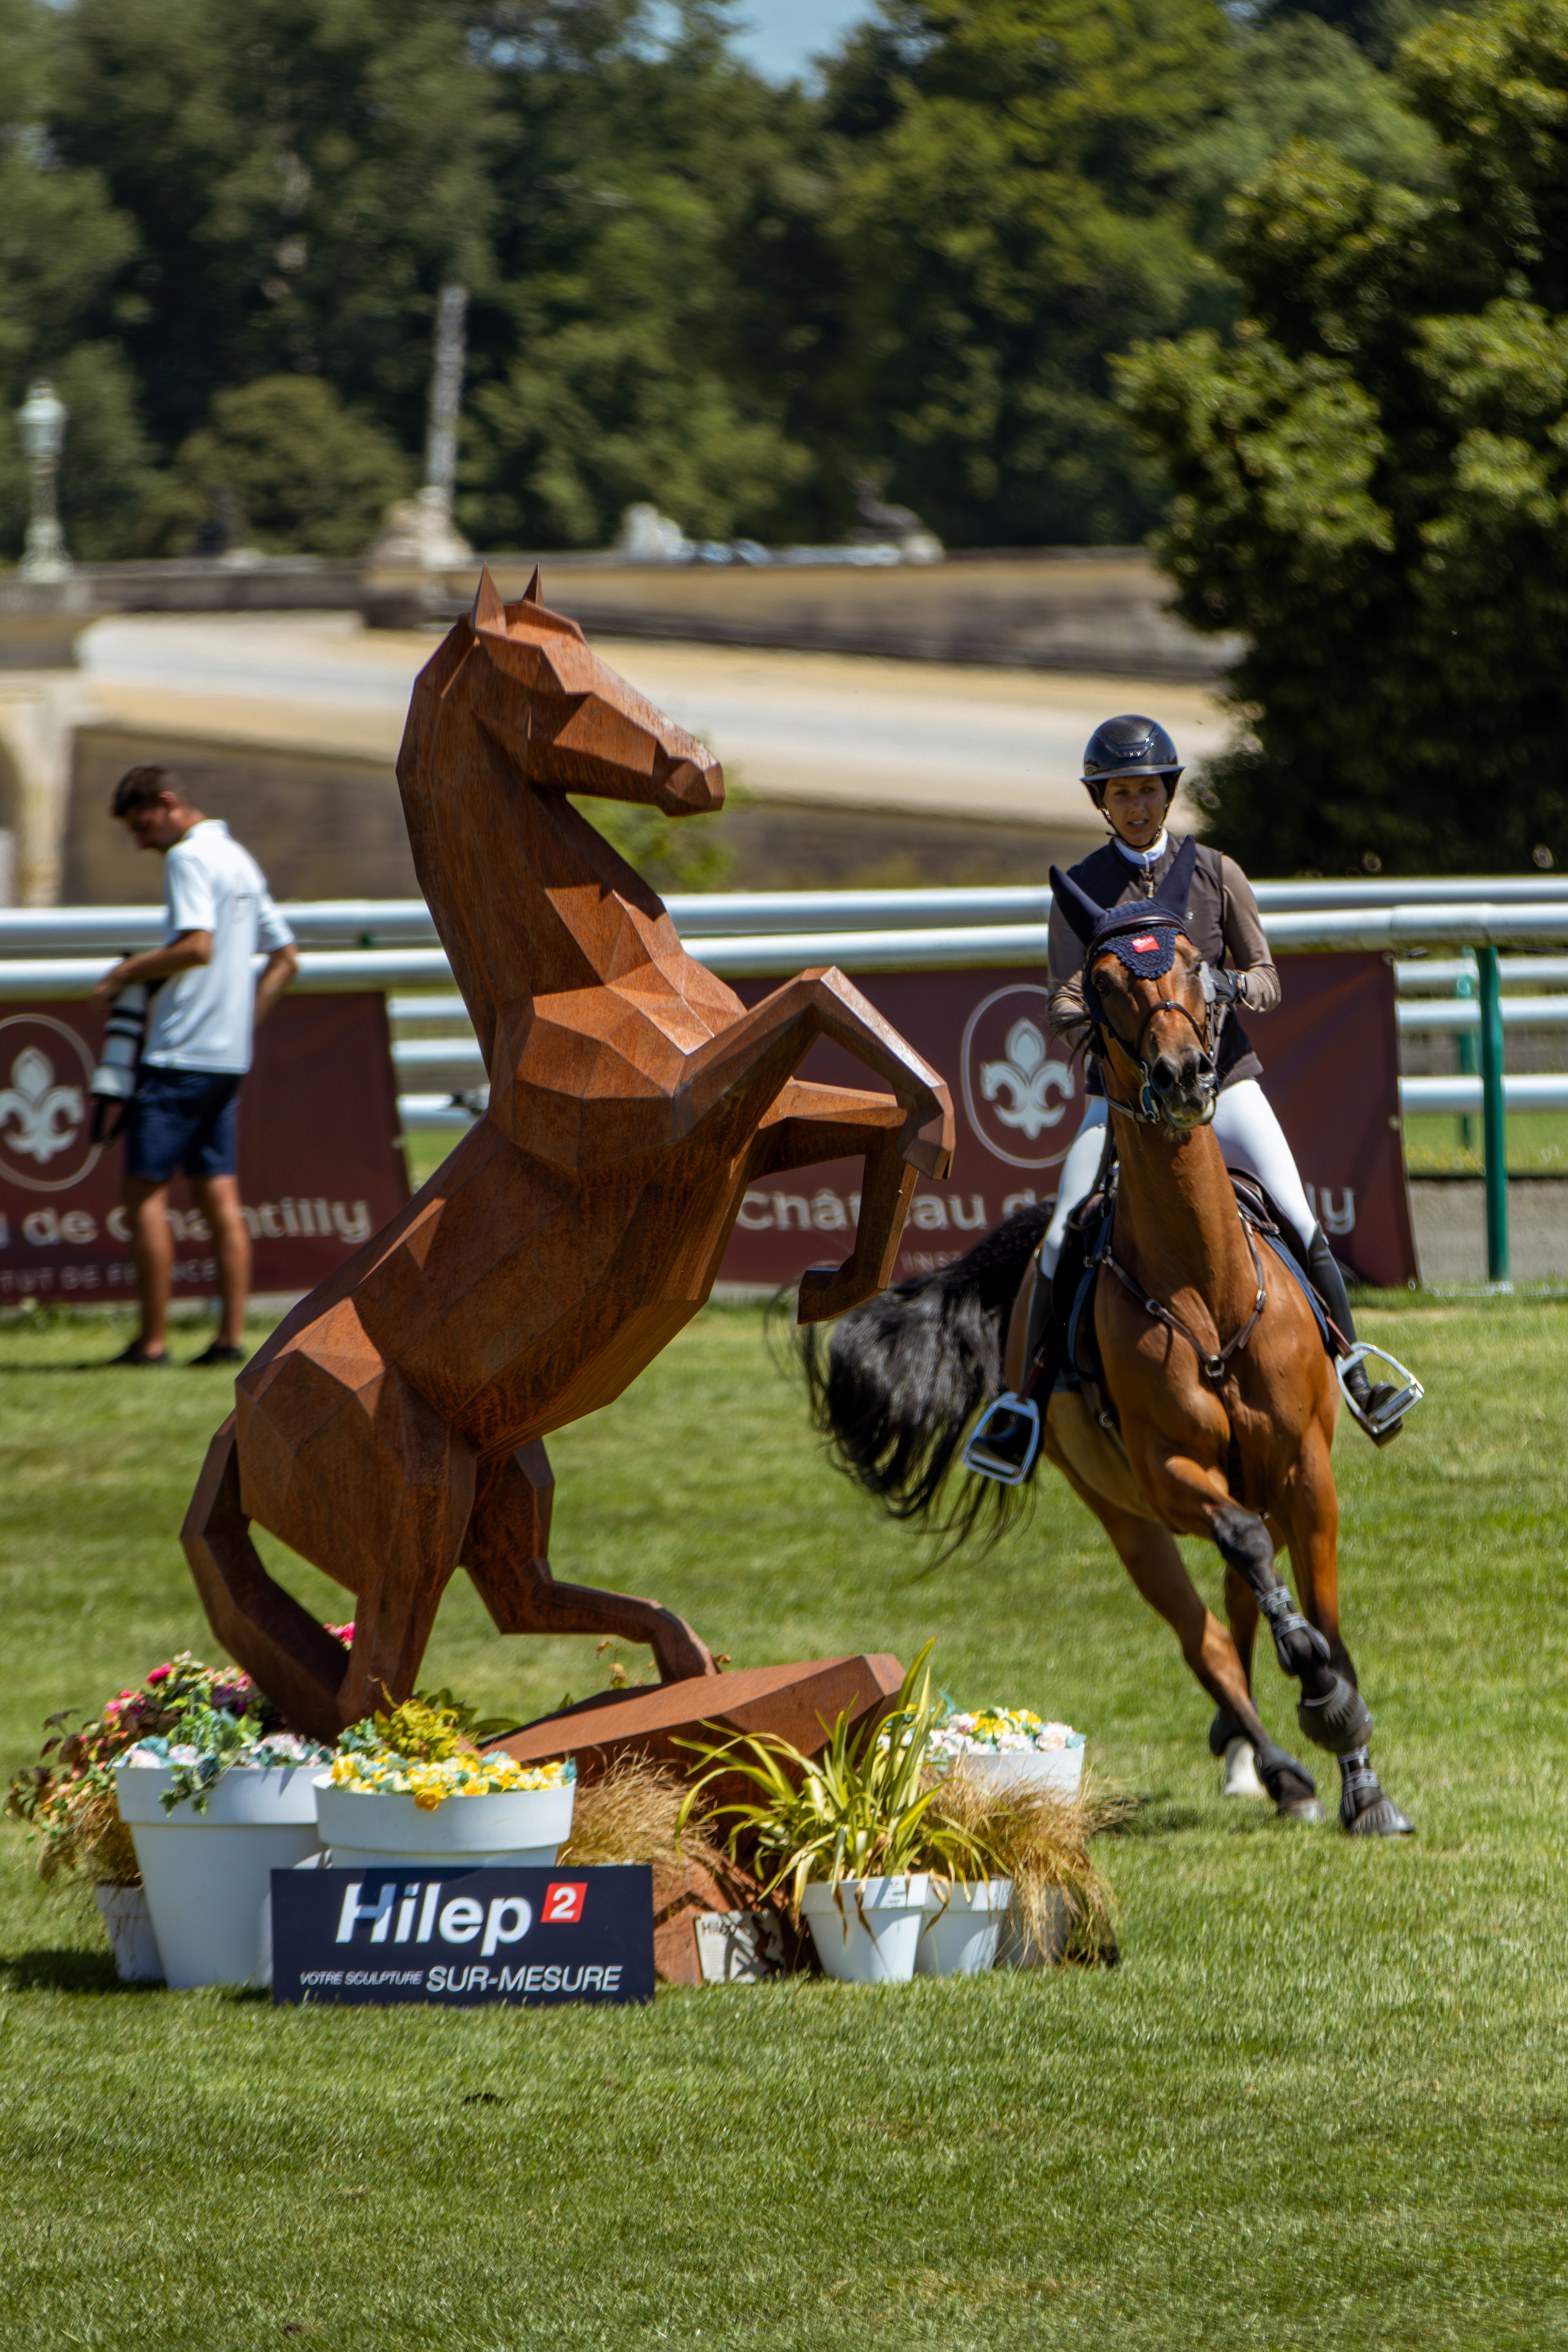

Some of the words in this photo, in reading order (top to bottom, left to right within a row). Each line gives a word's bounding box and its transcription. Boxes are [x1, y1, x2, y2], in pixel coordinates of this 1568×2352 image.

[22, 1207, 99, 1245] de
[735, 1187, 987, 1231] Châtau
[336, 1883, 532, 1957] Hilep
[300, 1970, 345, 1985] VOTRE
[345, 1970, 424, 1985] SCULPTURE
[426, 1965, 623, 1992] SUR-MESURE
